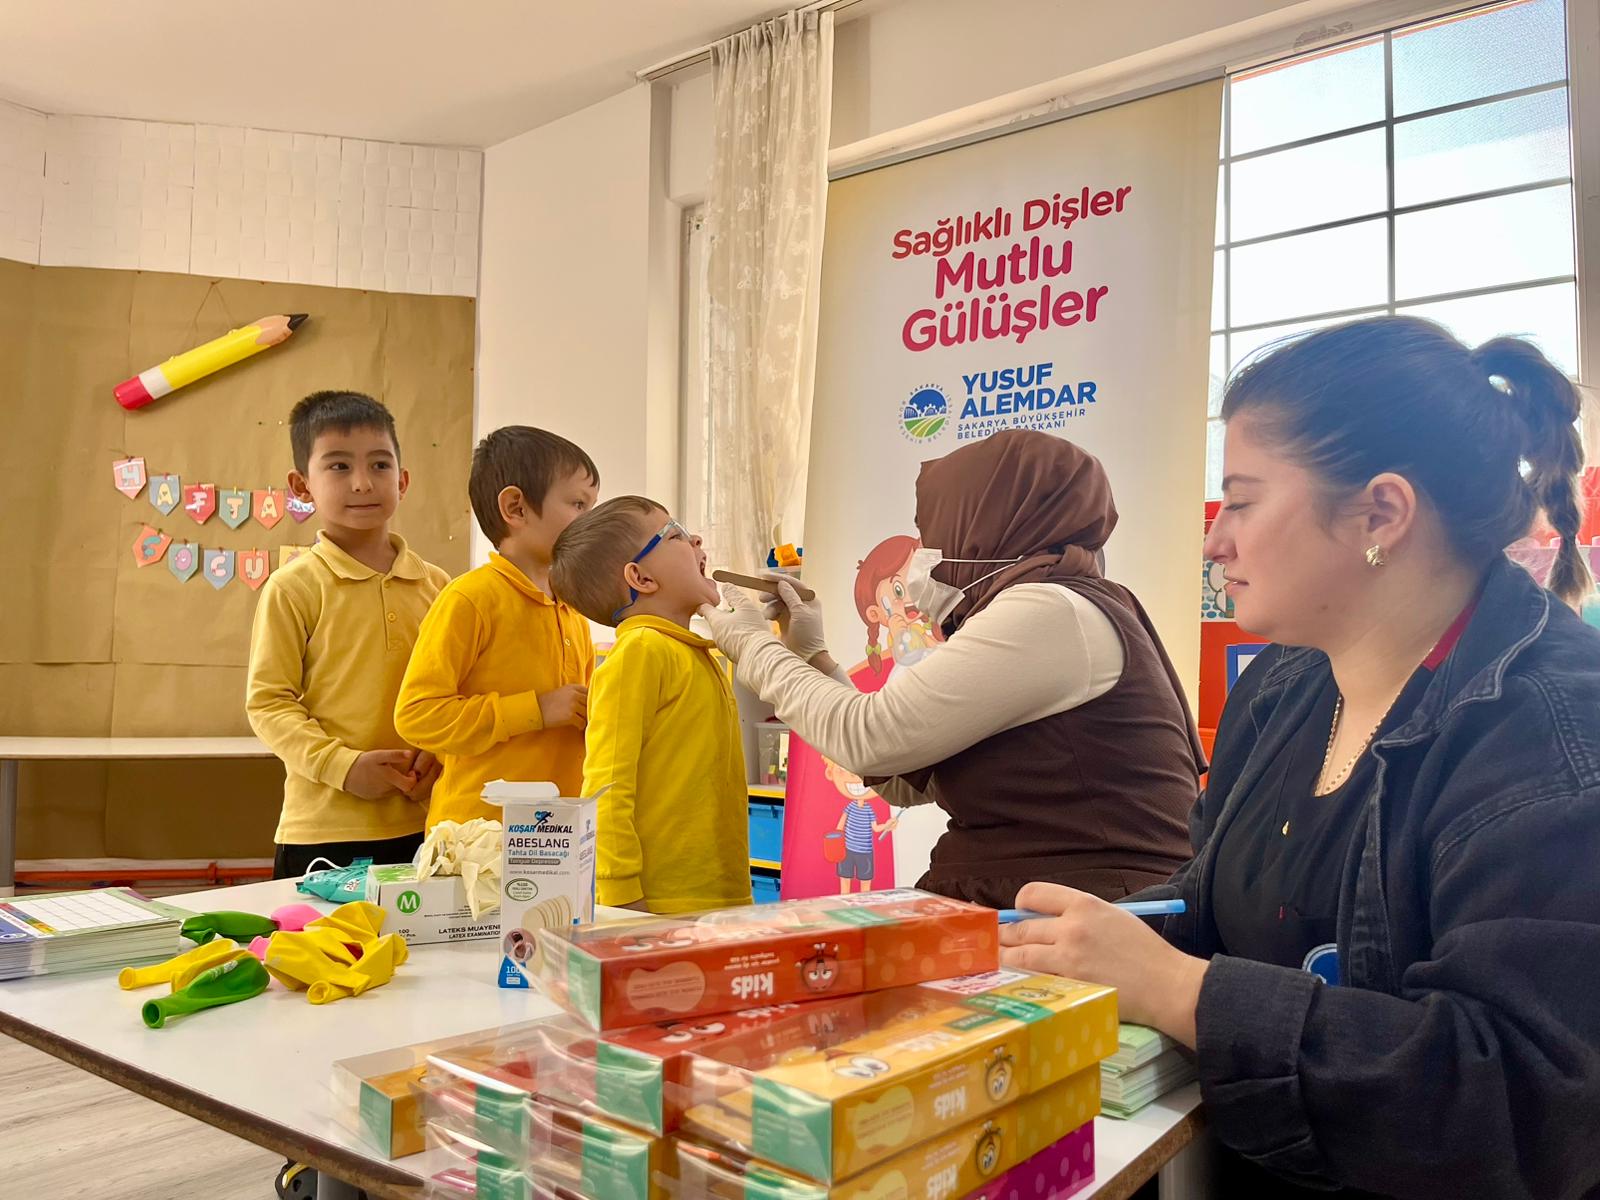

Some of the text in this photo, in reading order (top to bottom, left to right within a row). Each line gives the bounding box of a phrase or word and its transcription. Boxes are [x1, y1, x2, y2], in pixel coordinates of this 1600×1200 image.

[891, 186, 1132, 260] Sağlıklı Dişler
[935, 235, 1073, 299] Mutlu
[902, 284, 1109, 351] Gülüşler
[962, 362, 1053, 395] YUSUF
[960, 381, 1097, 420] ALEMDAR
[957, 408, 1086, 432] SAKARYA BÜYÜKŞEHİR
[119, 463, 312, 518] HAFTA
[508, 823, 574, 834] KOŞAR MEDİKAL
[508, 837, 570, 849] ABESLANG
[400, 894, 418, 910] M
[438, 926, 466, 935] LATEKS
[731, 971, 774, 999] kids
